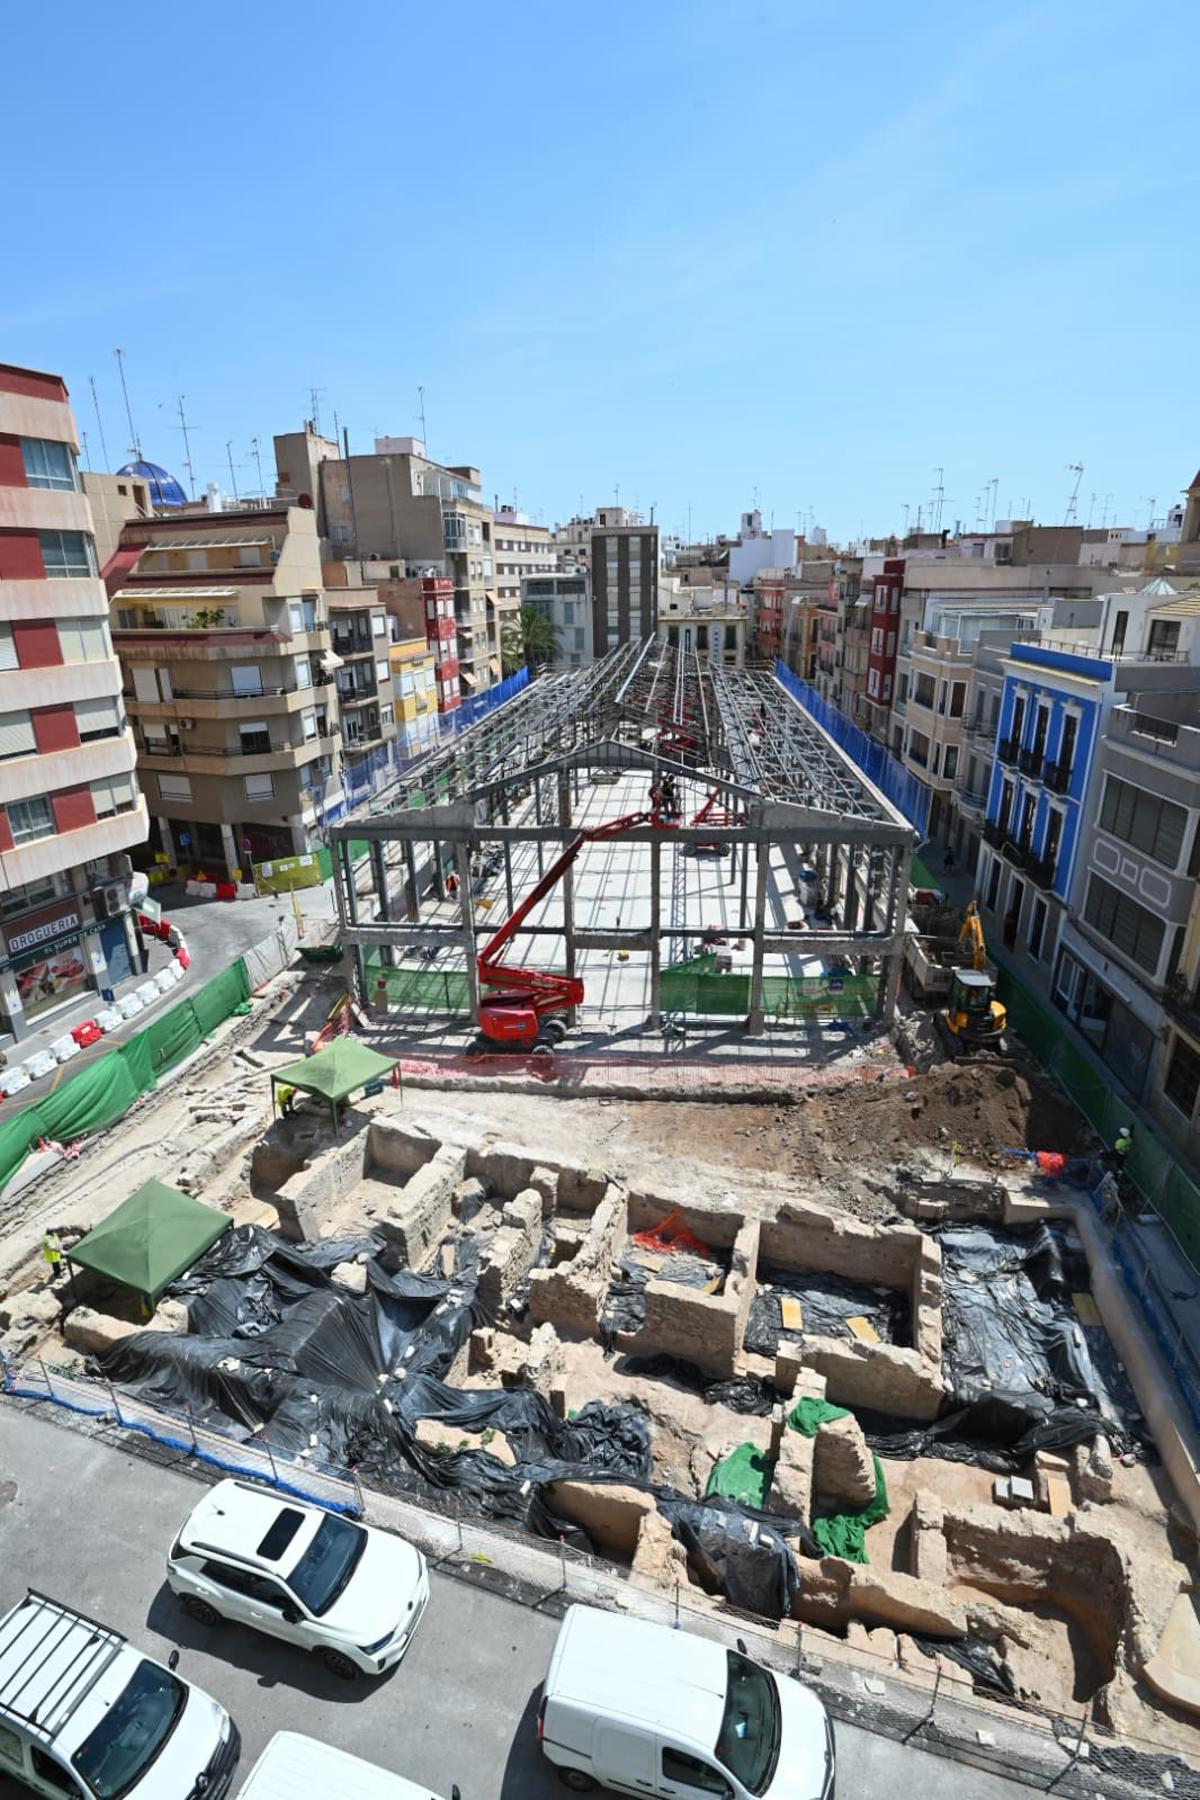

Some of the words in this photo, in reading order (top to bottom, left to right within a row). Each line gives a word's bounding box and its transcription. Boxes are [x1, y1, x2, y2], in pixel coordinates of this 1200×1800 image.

[11, 915, 77, 950] DROGUERIA
[54, 937, 78, 949] SUPER
[79, 931, 89, 939] DE
[90, 924, 106, 934] CASA
